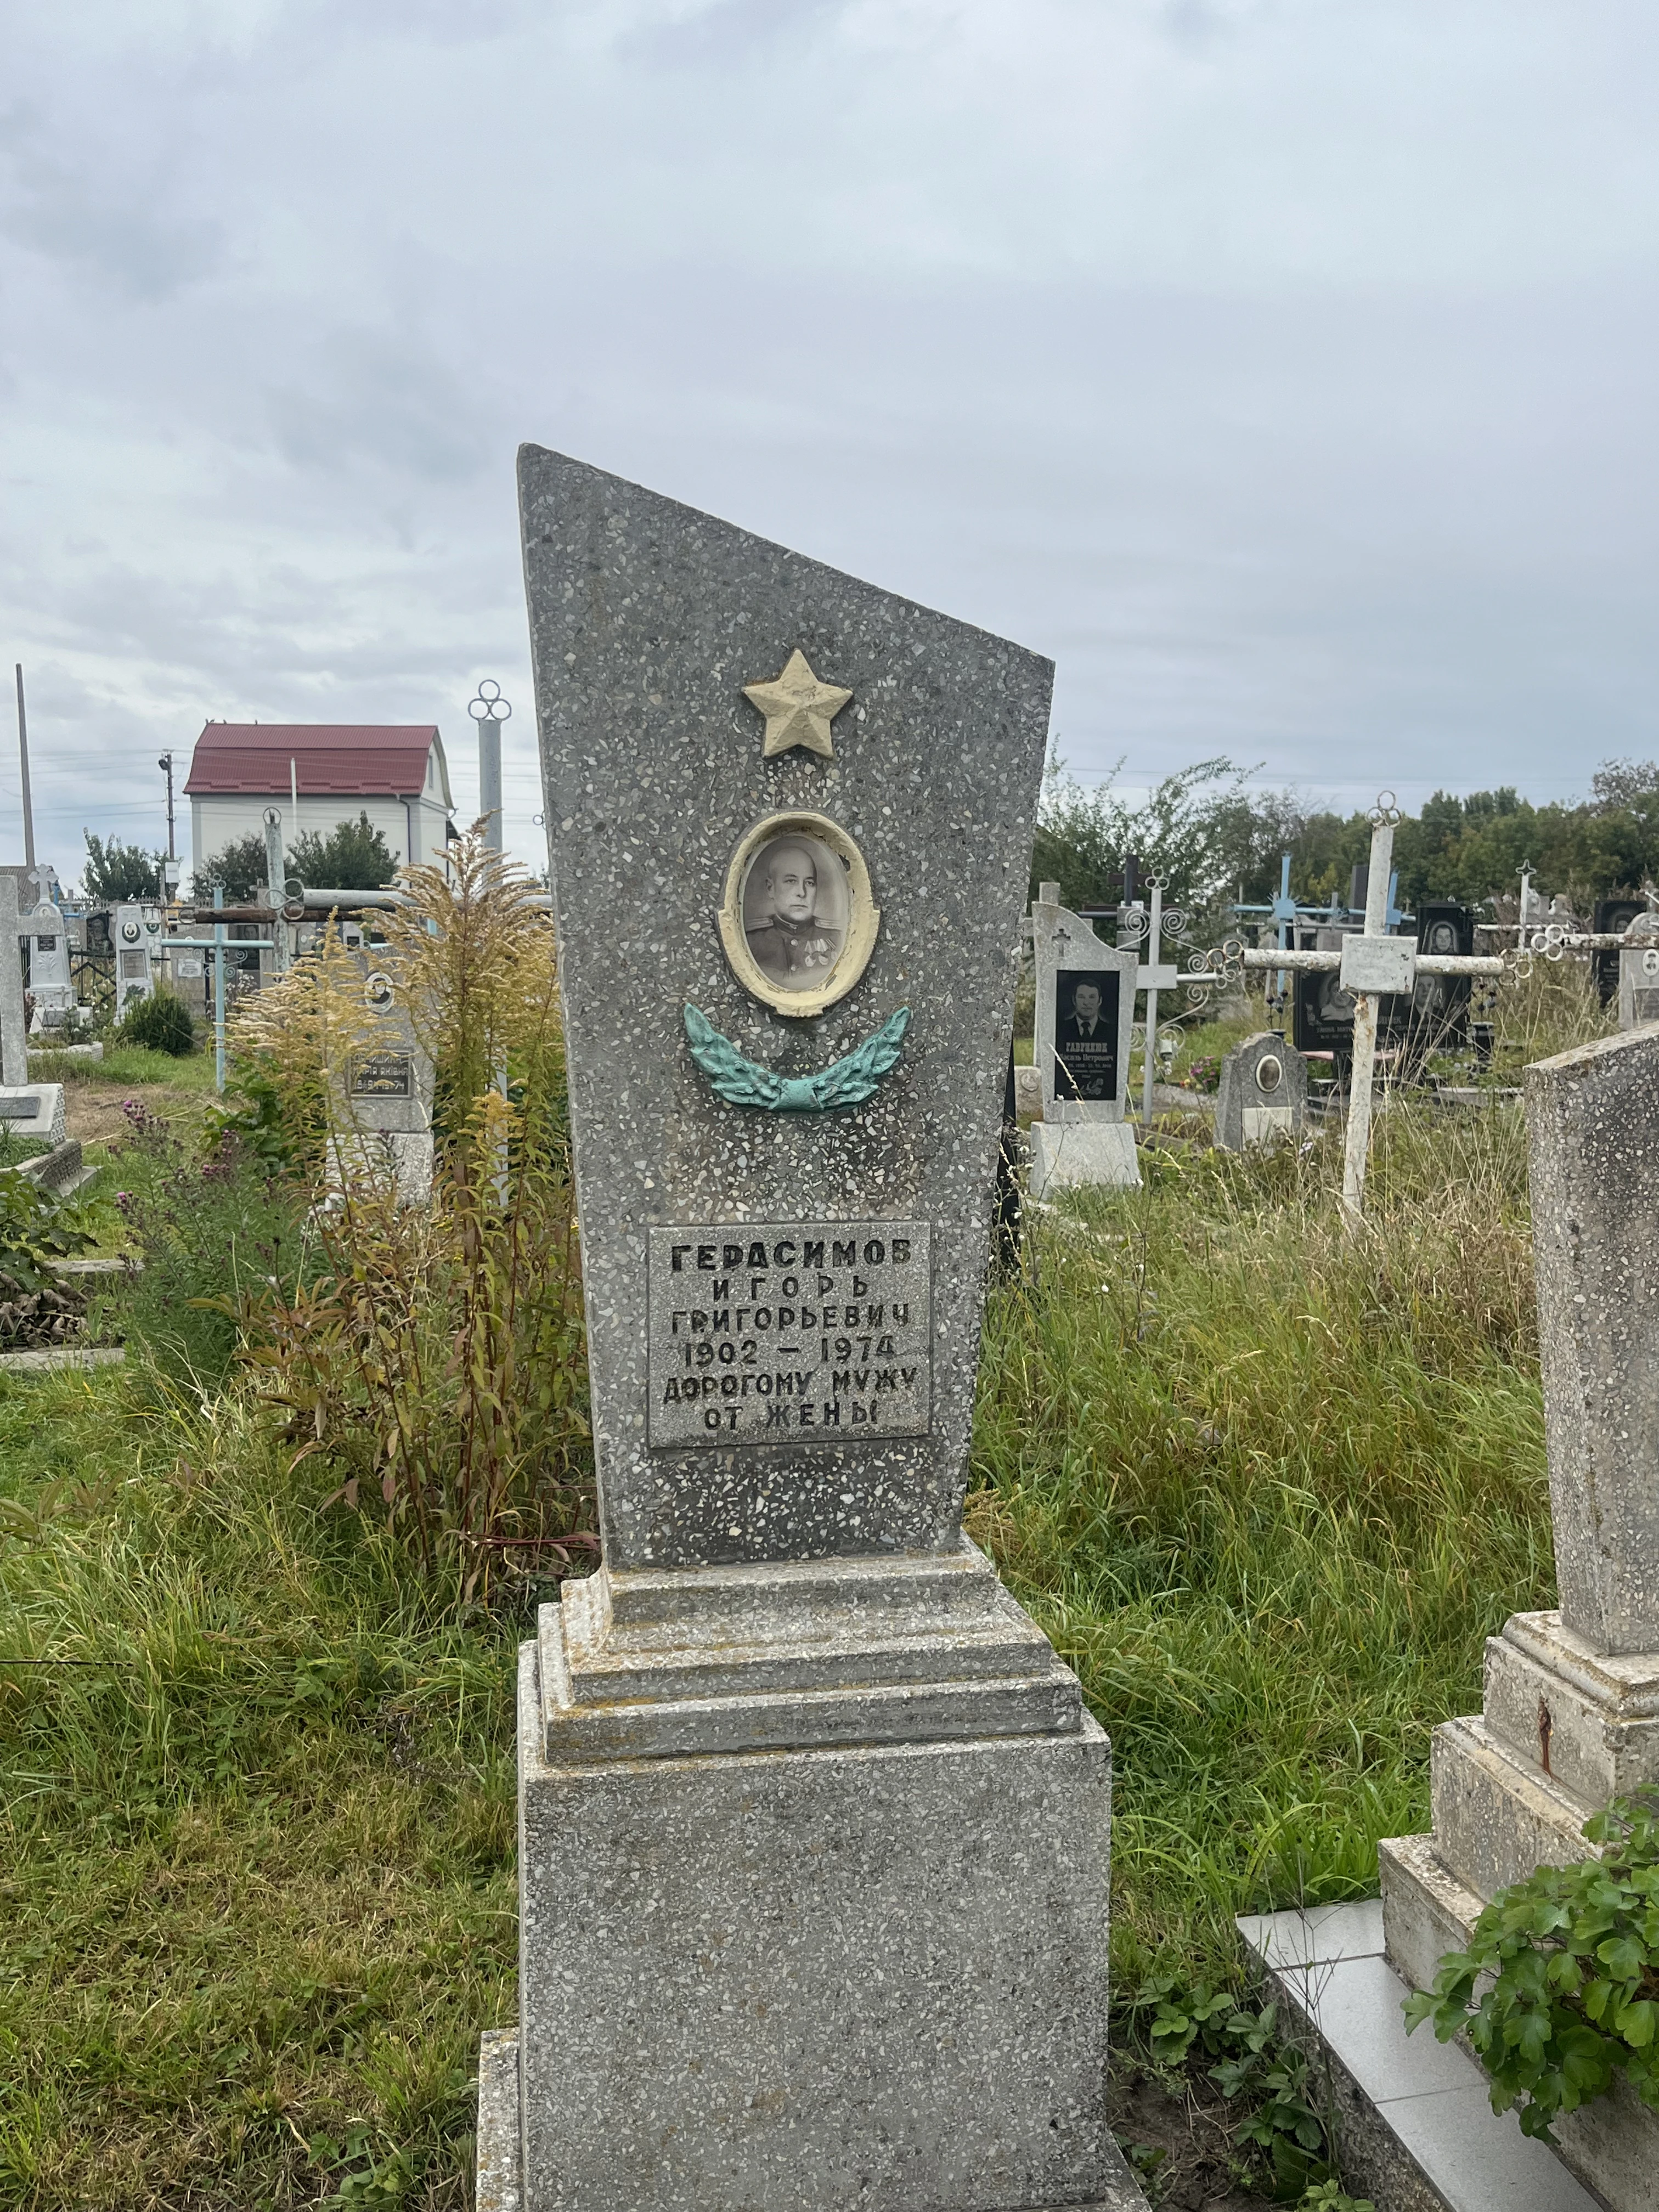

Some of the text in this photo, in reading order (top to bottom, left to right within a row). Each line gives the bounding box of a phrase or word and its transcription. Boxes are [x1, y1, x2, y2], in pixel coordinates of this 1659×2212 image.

[672, 1239, 911, 1272] ГЕРАСИМОВ
[713, 1274, 867, 1301] ИГОРЬ
[672, 1303, 909, 1335] ГРИГОРЬЕВИЧ
[685, 1339, 758, 1368] 1902
[821, 1335, 895, 1364] 1974
[663, 1367, 917, 1405] ДОРОГОМУ МУЖУ
[704, 1399, 878, 1431] ОТ ЖЕНЫ
